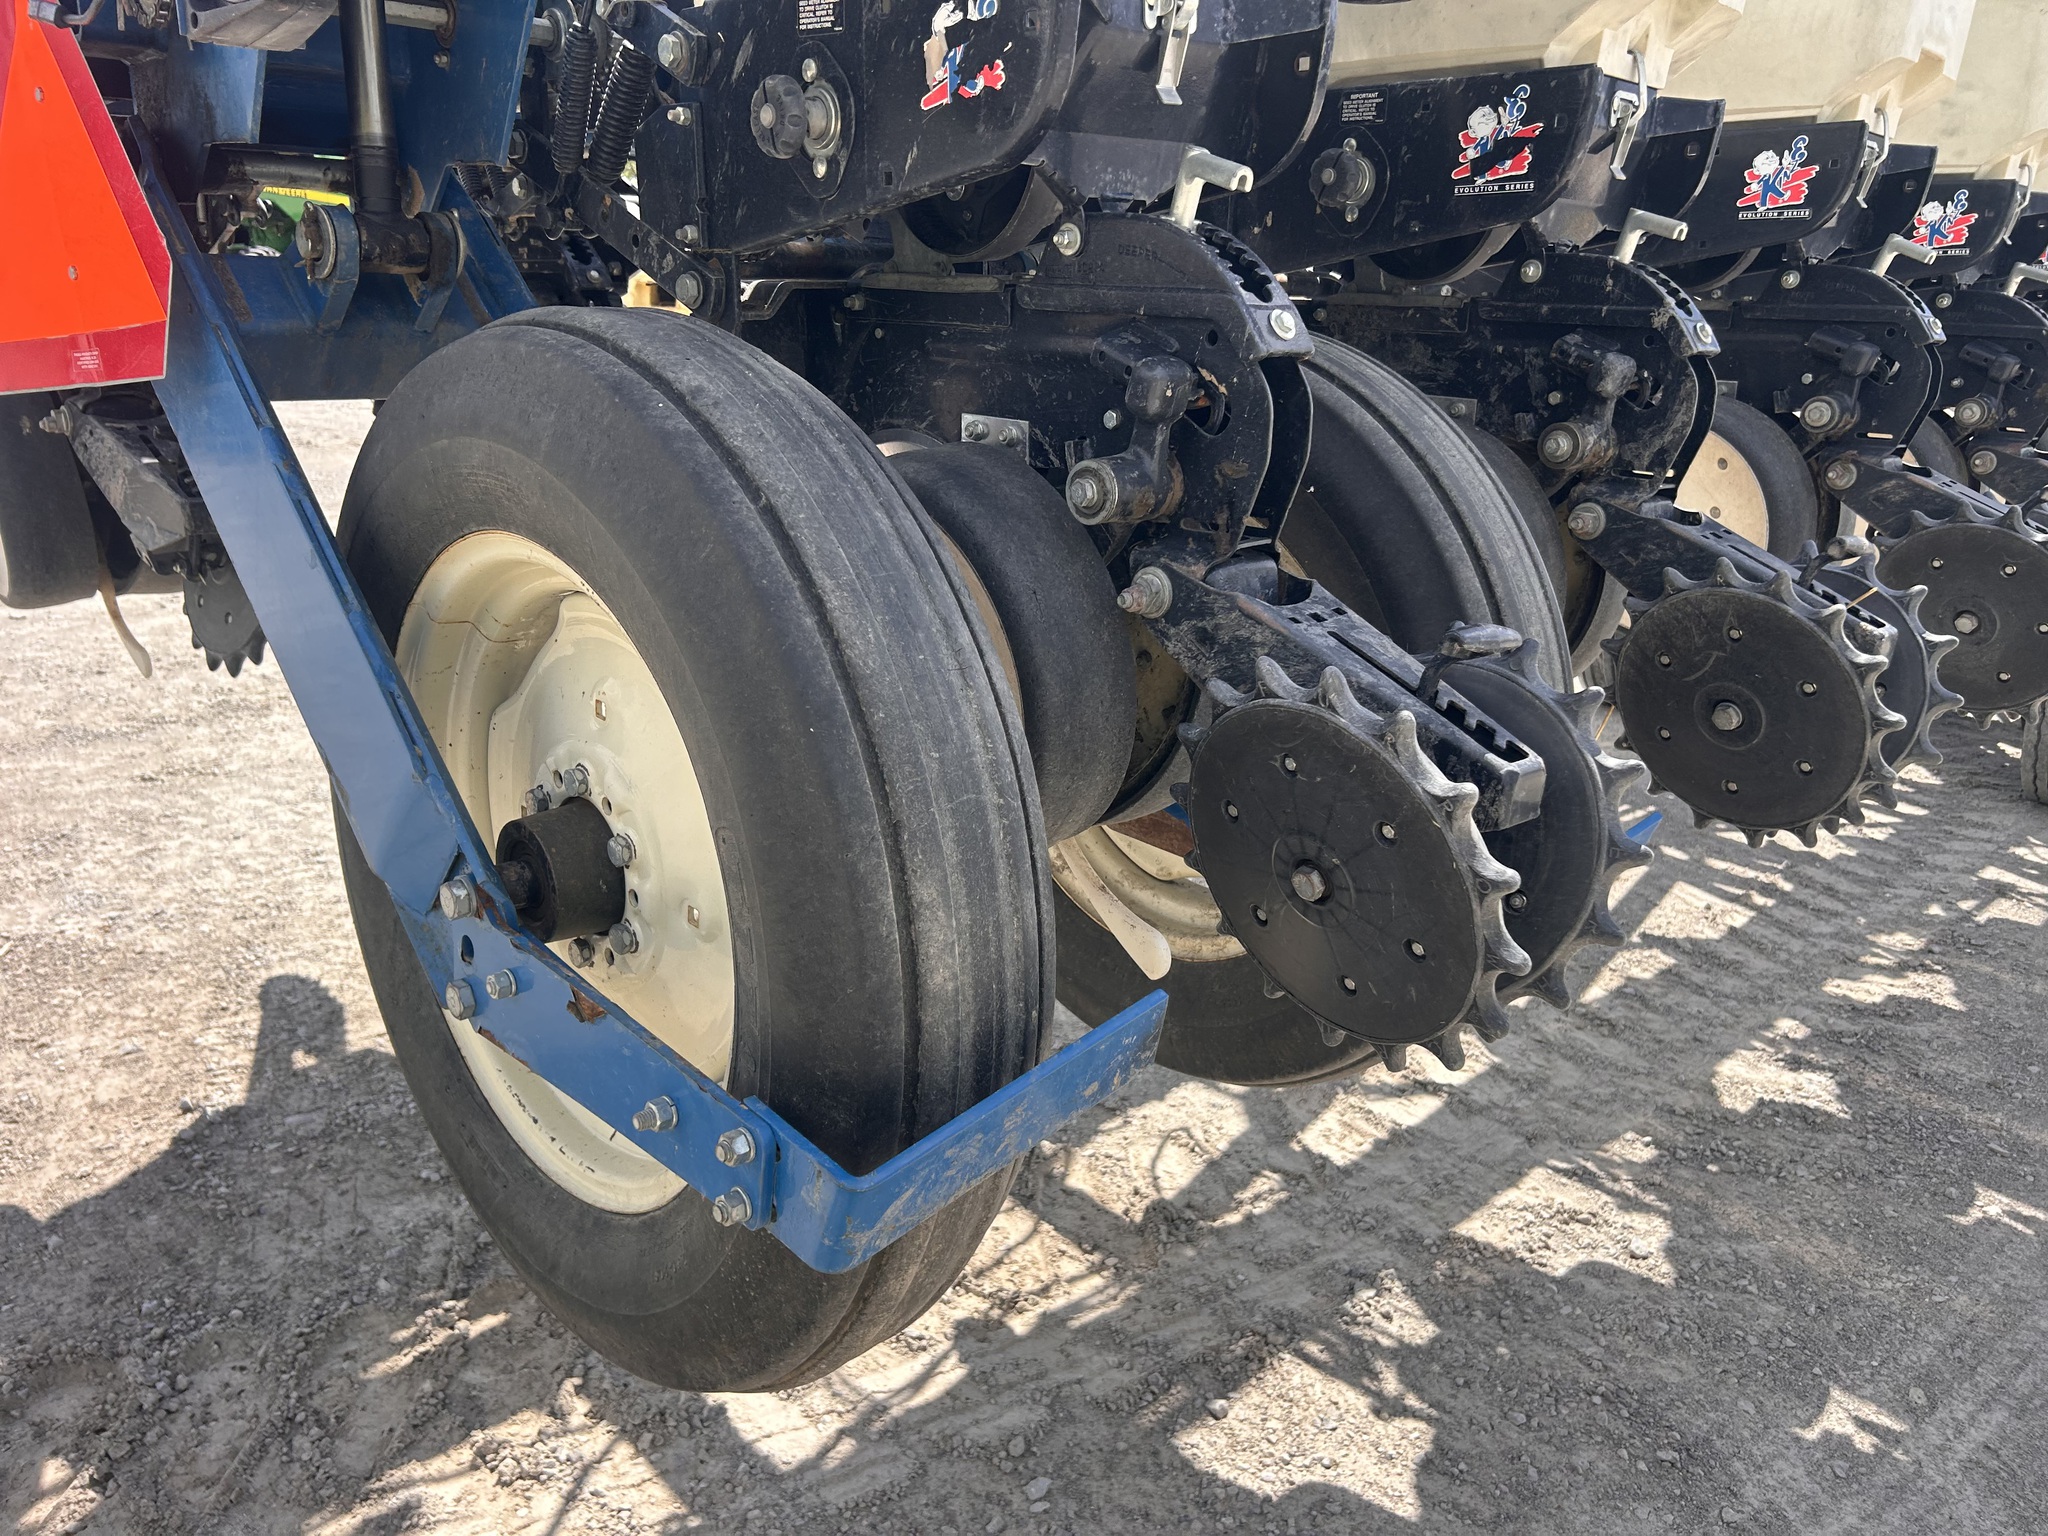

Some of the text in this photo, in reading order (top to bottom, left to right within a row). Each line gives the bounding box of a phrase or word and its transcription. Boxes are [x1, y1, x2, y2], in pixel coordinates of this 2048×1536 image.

[1454, 182, 1535, 194] EVOLUTION SERIES
[1118, 243, 1159, 261] DEEPER
